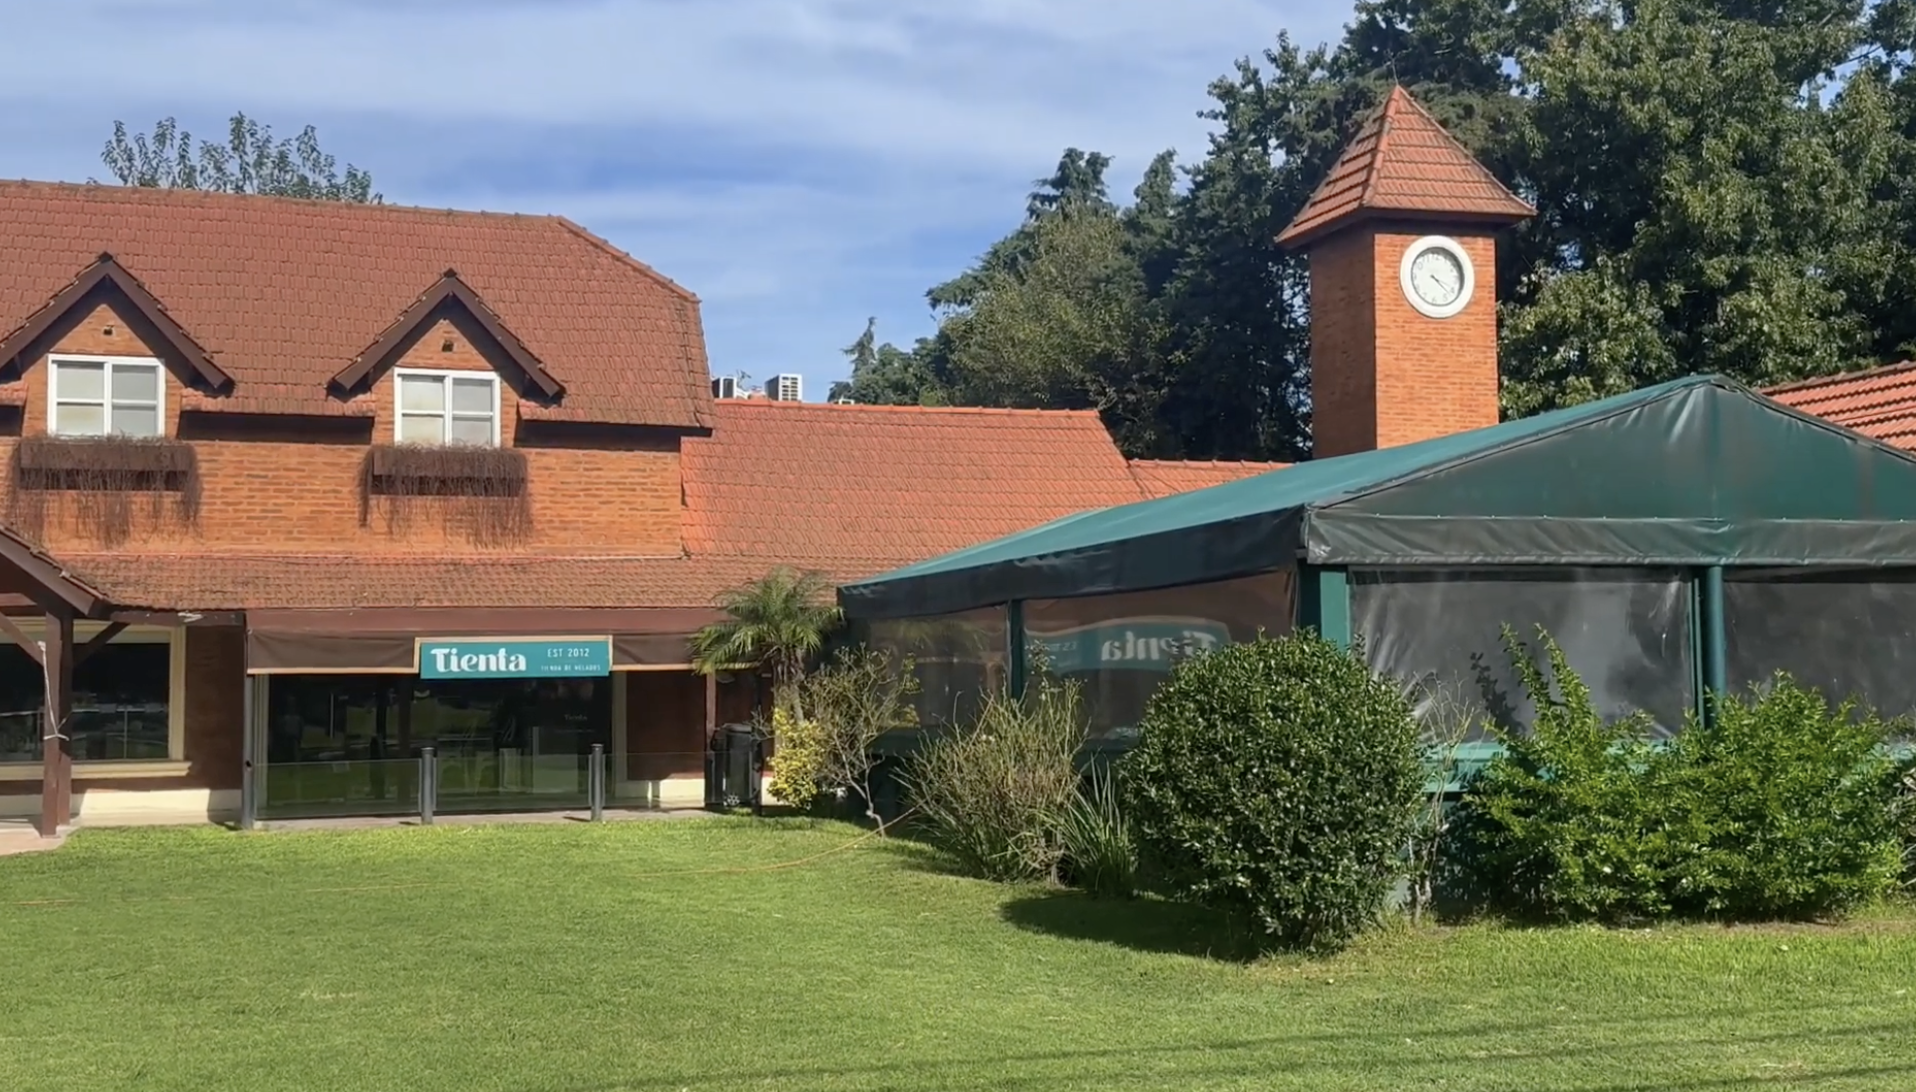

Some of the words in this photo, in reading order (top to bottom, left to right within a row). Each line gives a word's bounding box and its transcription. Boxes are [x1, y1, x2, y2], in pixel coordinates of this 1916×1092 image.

[430, 647, 527, 672] Tienta
[547, 648, 563, 658] EST
[567, 648, 590, 658] 2012
